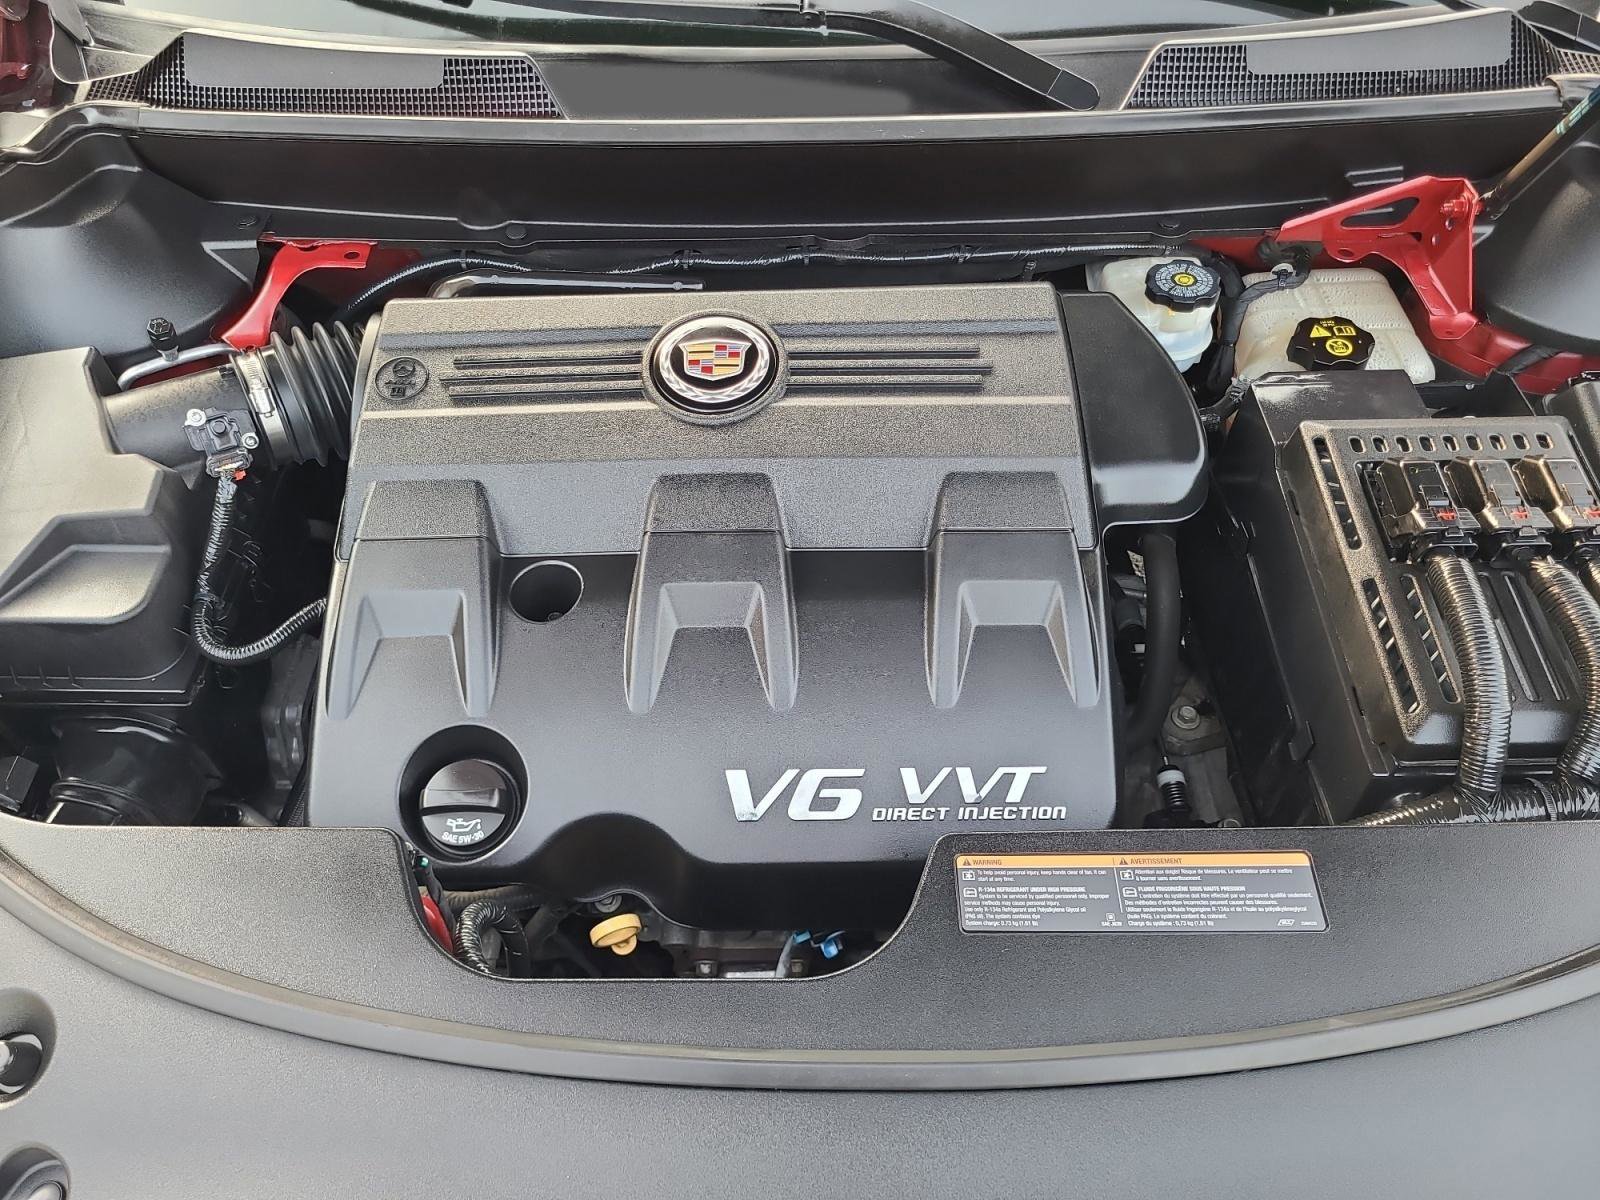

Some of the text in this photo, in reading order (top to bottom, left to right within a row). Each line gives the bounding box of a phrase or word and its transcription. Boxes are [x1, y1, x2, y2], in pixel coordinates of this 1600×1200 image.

[725, 766, 1047, 821] V6 VVT
[872, 805, 1067, 821] DIRECT INJECTION
[442, 831, 484, 843] SAE 5W-30
